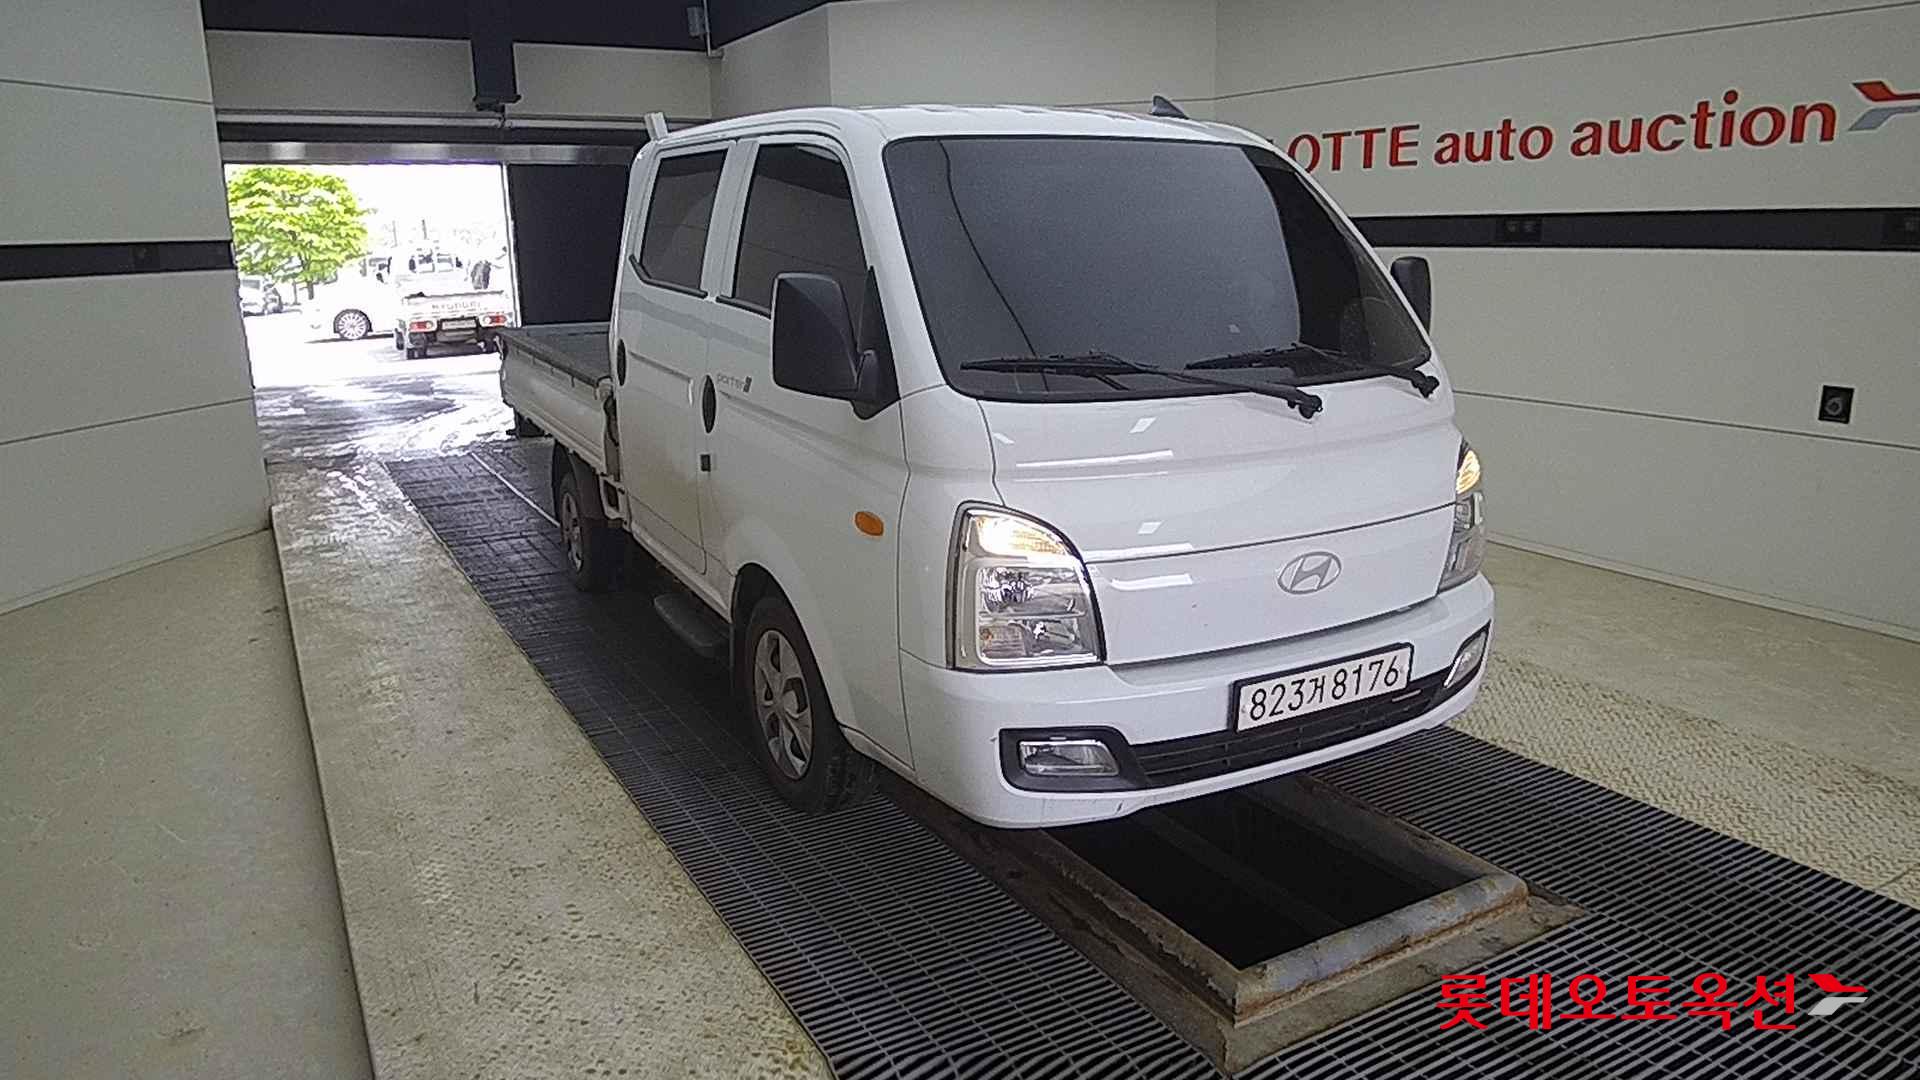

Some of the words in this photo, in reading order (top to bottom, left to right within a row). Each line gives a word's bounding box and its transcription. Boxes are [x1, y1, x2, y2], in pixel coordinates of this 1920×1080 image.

[1267, 123, 1420, 173] OTTE
[1433, 118, 1553, 166] auto
[1569, 89, 1837, 157] auction
